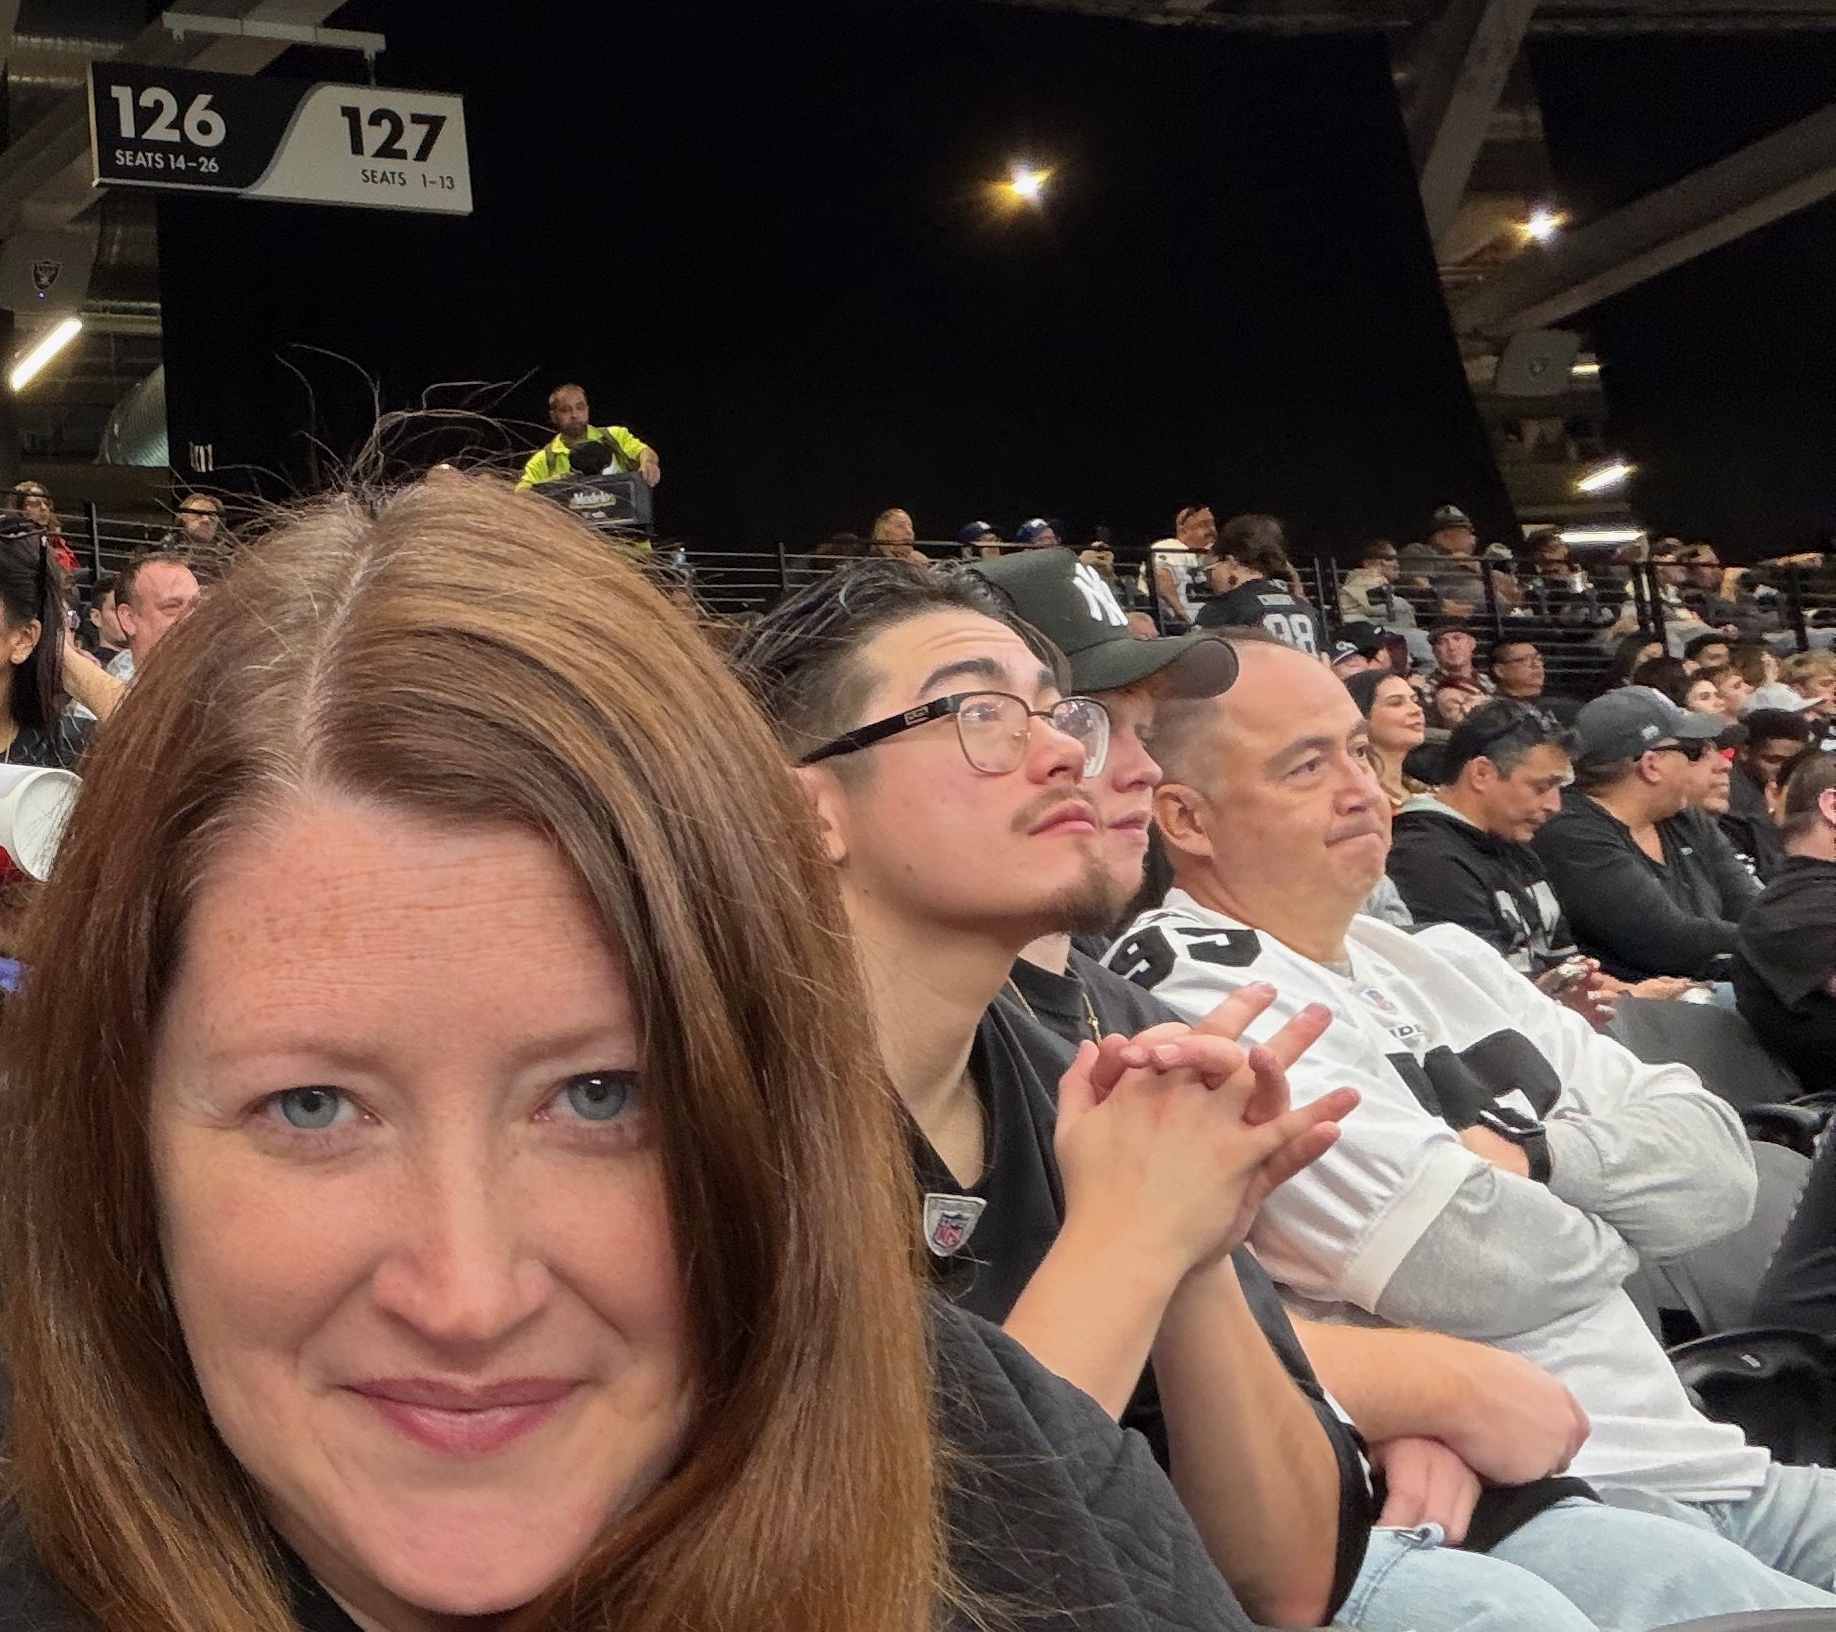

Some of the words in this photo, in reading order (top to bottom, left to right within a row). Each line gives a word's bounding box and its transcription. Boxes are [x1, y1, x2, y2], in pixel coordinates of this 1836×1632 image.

[110, 84, 227, 148] 126
[339, 104, 448, 164] 127
[114, 148, 164, 170] SEATS
[168, 154, 220, 174] 14-26
[360, 168, 407, 188] SEATS
[420, 173, 455, 191] 1-13
